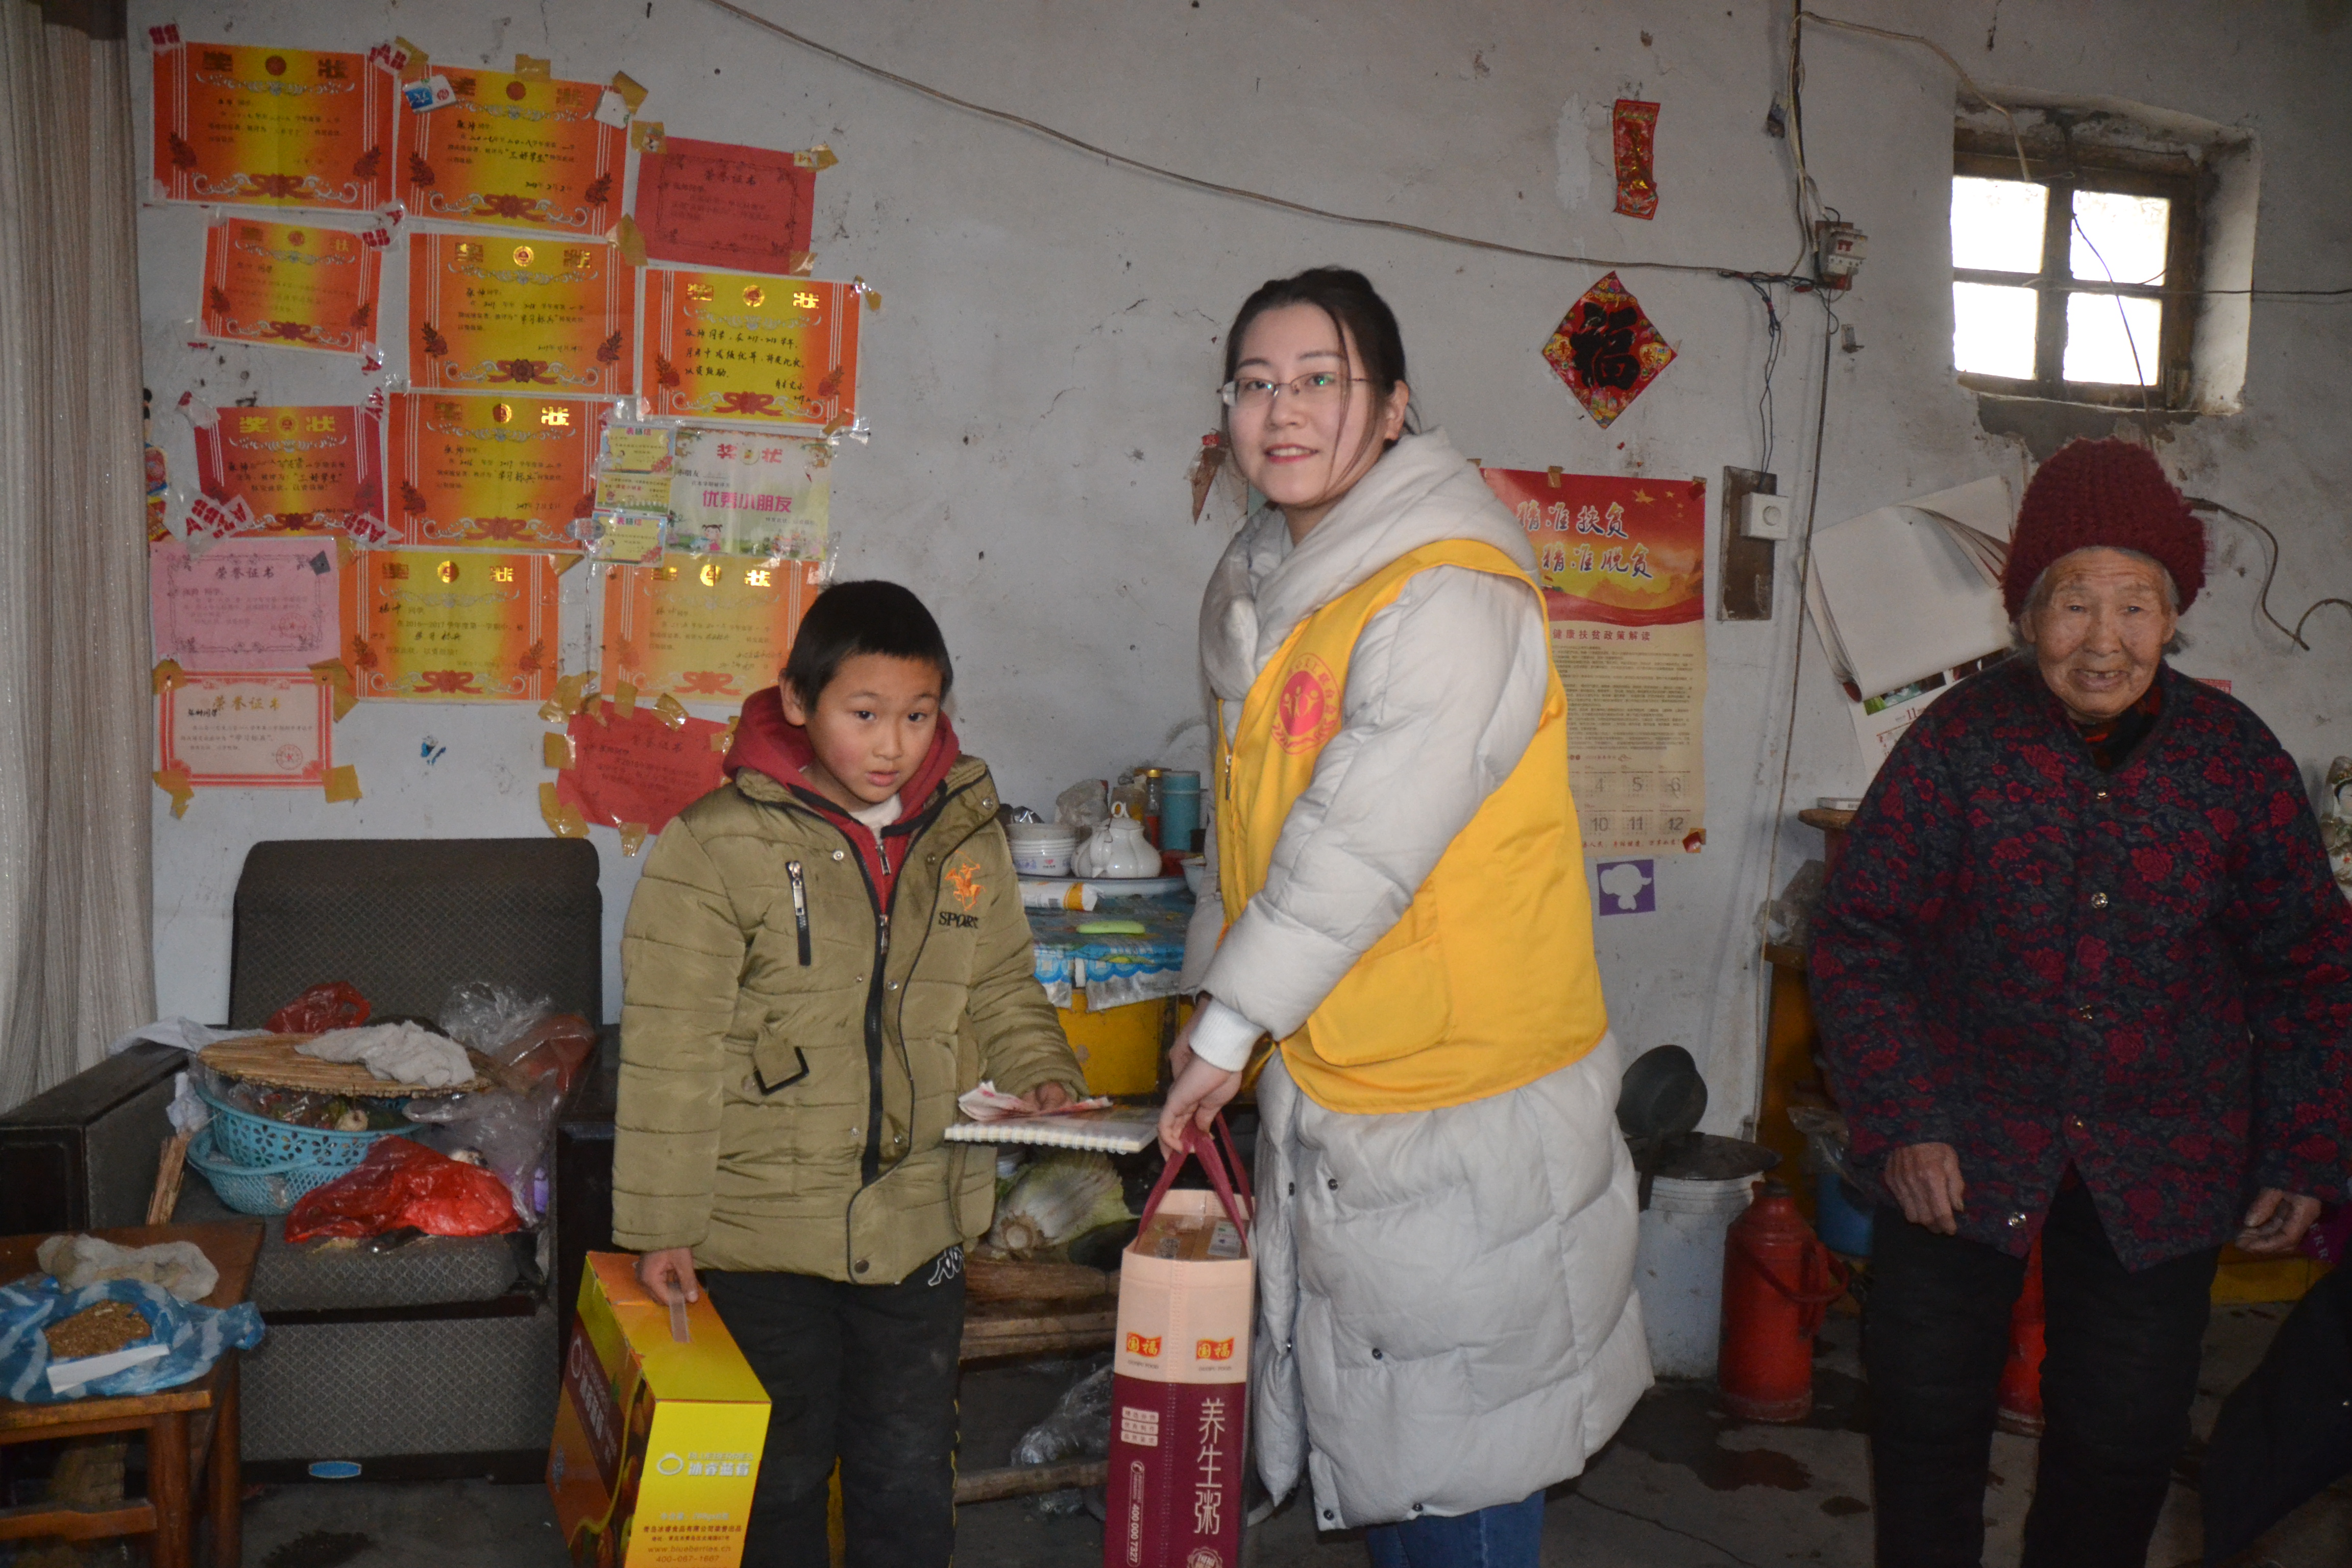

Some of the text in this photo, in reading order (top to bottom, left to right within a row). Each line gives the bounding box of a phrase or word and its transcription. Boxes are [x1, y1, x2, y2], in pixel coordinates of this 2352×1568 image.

[717, 443, 783, 463] 奖 状
[702, 489, 793, 512] 优秀小朋友
[1516, 499, 1629, 540] 精准扶贫
[1541, 542, 1653, 579] 精准脱贫
[1552, 628, 1651, 642] 健康扶贫政策解读
[1595, 777, 1604, 792] 4
[1632, 776, 1643, 792] 5
[1591, 816, 1684, 832] 10 11 12
[688, 1452, 754, 1461] BLUEBERRIES
[1193, 1397, 1226, 1535] 养生粥
[1131, 1504, 1140, 1521] 400
[1131, 1523, 1139, 1540] 000
[648, 1545, 731, 1553] www.blueberries.cn
[1130, 1541, 1139, 1563] 7327
